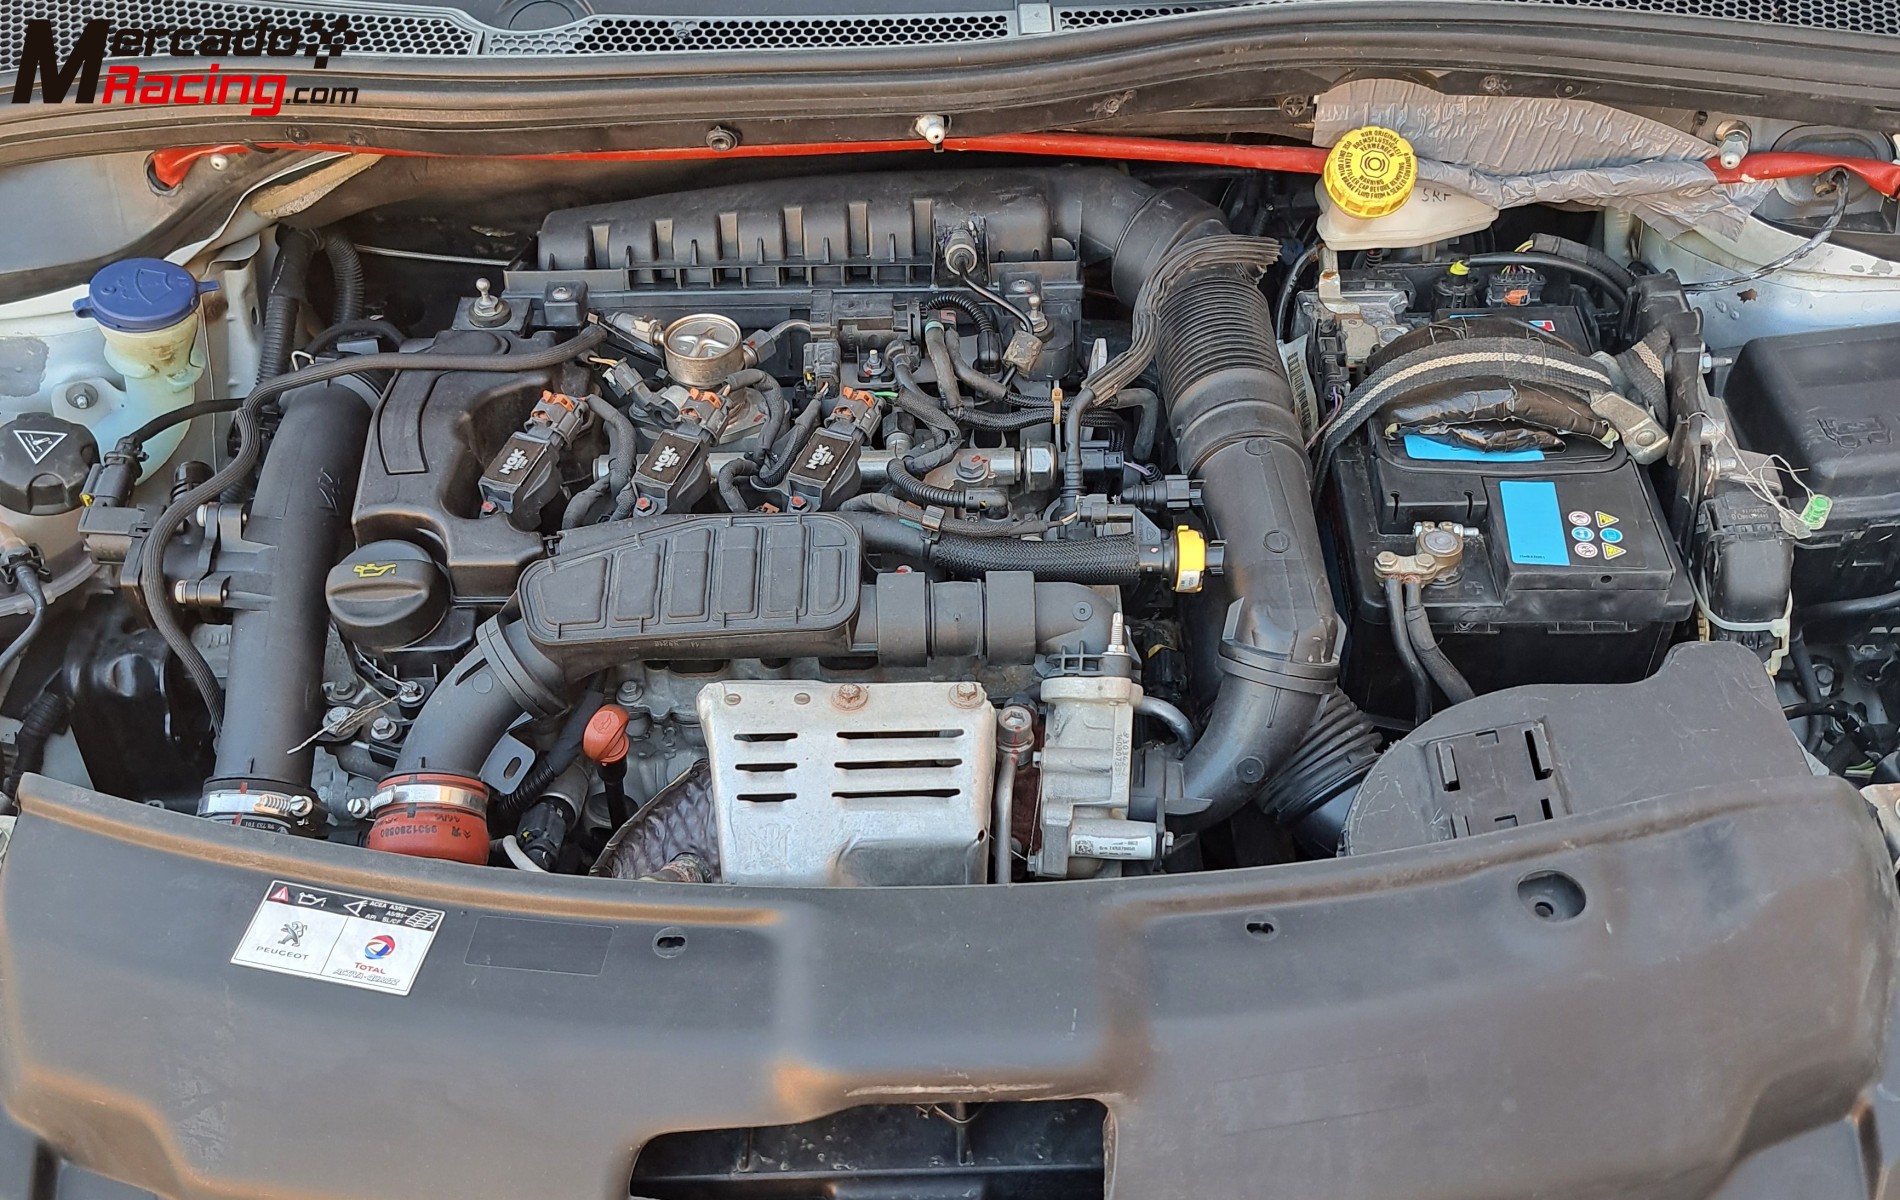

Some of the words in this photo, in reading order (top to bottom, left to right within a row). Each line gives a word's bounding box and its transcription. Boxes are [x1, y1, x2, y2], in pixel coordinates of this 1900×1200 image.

[1374, 130, 1400, 144] ORIGINAL
[1342, 140, 1353, 151] USE
[1338, 149, 1347, 163] ONLY
[1345, 152, 1353, 169] CLEAN
[1403, 151, 1412, 181] CONTAINER
[1341, 175, 1355, 191] BRAKE
[1345, 168, 1361, 186] FILLER
[1354, 186, 1371, 199] FLUID
[1358, 182, 1368, 191] CAP
[1369, 183, 1390, 193] BEFORE
[1390, 179, 1408, 196] SEALED
[1370, 192, 1387, 200] FROM
[651, 445, 676, 472] NGK
[805, 444, 830, 470] NGK
[369, 900, 387, 909] ACEA
[255, 944, 309, 961] PEUGEOT
[354, 961, 387, 975] TOTAL
